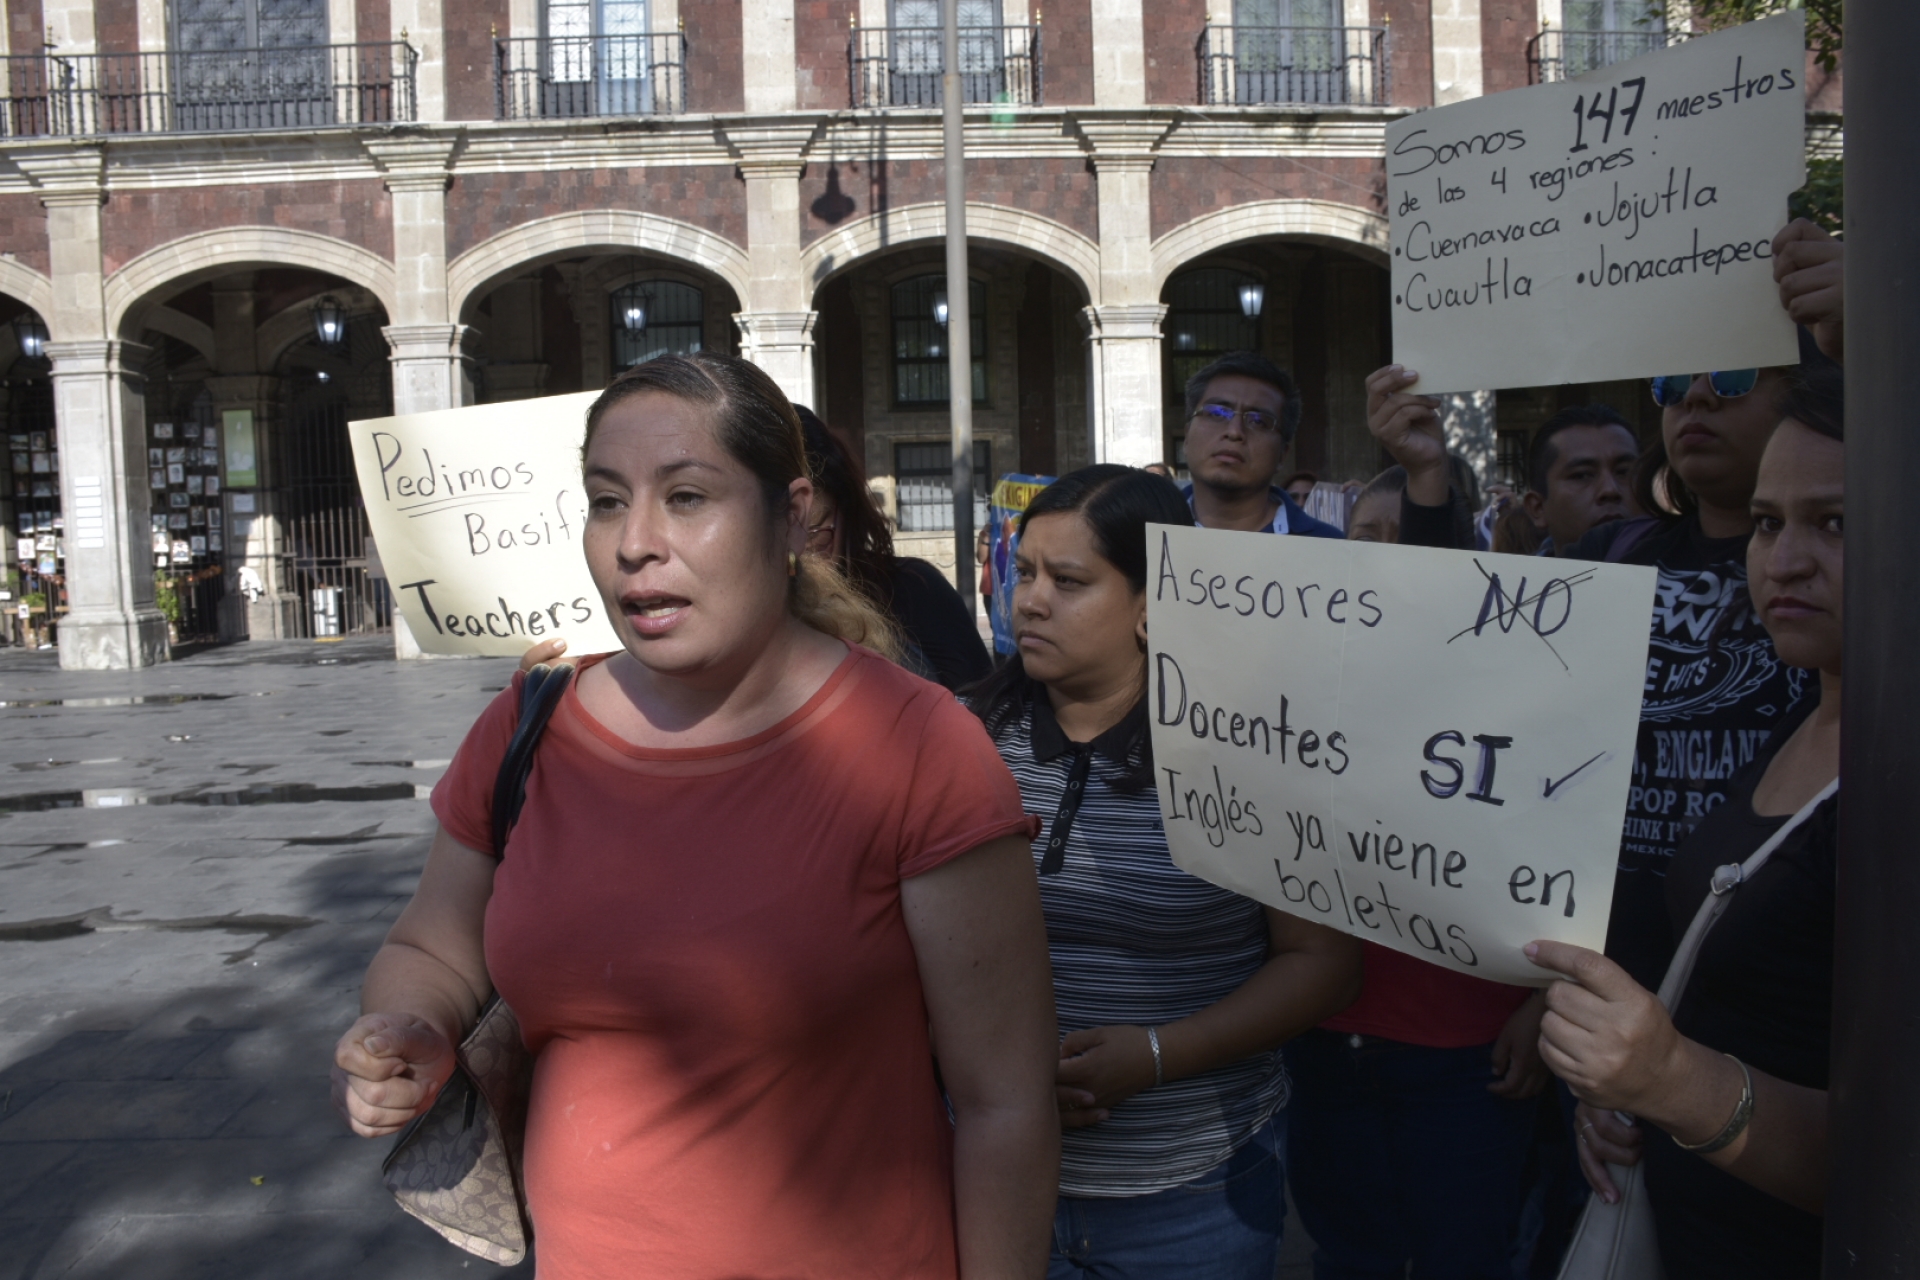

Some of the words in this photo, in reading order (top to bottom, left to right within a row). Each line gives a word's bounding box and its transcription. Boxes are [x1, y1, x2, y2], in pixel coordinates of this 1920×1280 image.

[1394, 129, 1526, 176] Somos
[1569, 77, 1646, 153] 147
[1656, 56, 1796, 121] maestros
[1398, 191, 1421, 217] de
[1437, 178, 1466, 204] las
[1490, 167, 1507, 193] 4
[372, 432, 534, 501] Pedimos
[400, 579, 592, 638] Teachers
[1157, 531, 1383, 627] Asesores
[1473, 572, 1573, 637] NO
[1156, 652, 1350, 776] Docentes
[1420, 730, 1514, 807] SI
[1162, 765, 1264, 848] Inglés
[1286, 809, 1327, 861] ya
[1347, 820, 1467, 889] viene
[1508, 864, 1576, 918] en
[1623, 816, 1664, 840] HINK
[1625, 843, 1677, 857] MEXIC
[1274, 858, 1478, 967] boletas
